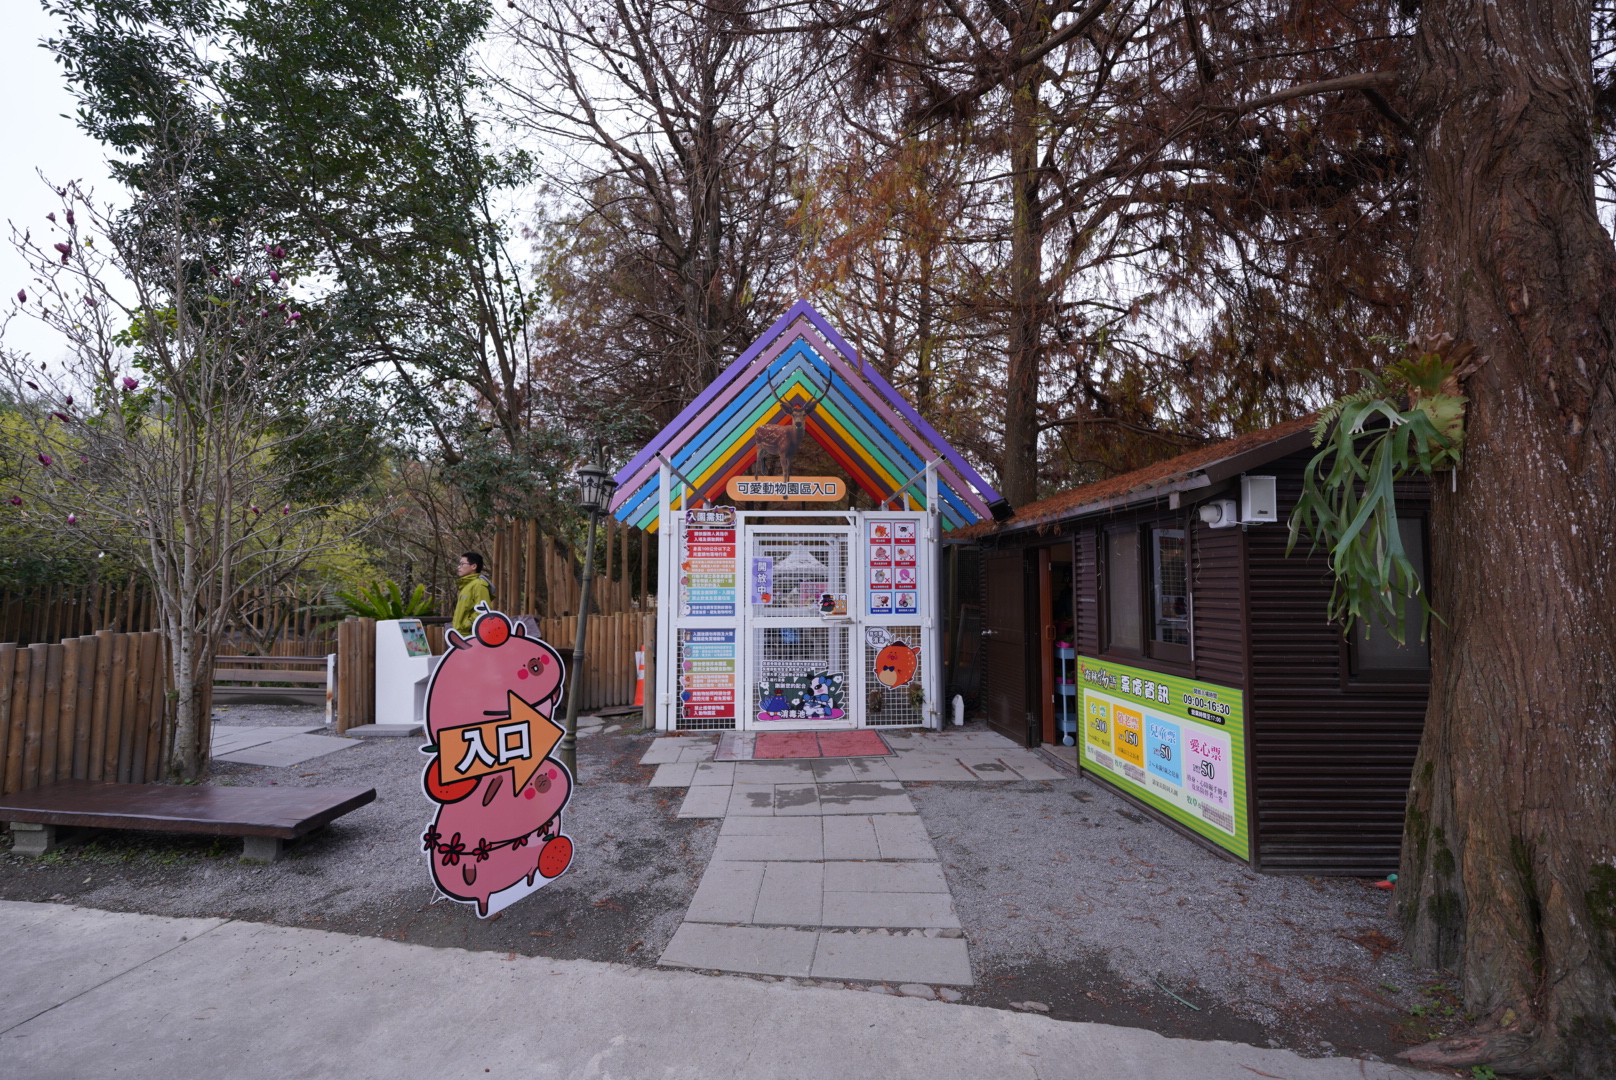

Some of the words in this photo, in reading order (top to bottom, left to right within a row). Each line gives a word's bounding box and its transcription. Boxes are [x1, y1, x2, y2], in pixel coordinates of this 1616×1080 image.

[737, 482, 836, 495] 可愛動物園區入口
[758, 562, 766, 595] 開放中
[1120, 674, 1170, 704] 票價資訊
[780, 710, 806, 719] 消毒池
[1090, 702, 1106, 718] 全票
[1183, 694, 1230, 716] 09:00-16:30
[1095, 718, 1107, 733] 200
[1117, 710, 1139, 730] 敬老票
[1124, 730, 1138, 746] 150
[1150, 723, 1176, 744] 兒童票
[456, 720, 532, 774] 入口
[1160, 744, 1171, 761] 50
[1190, 738, 1222, 761] 愛心票
[1201, 760, 1214, 779] 50
